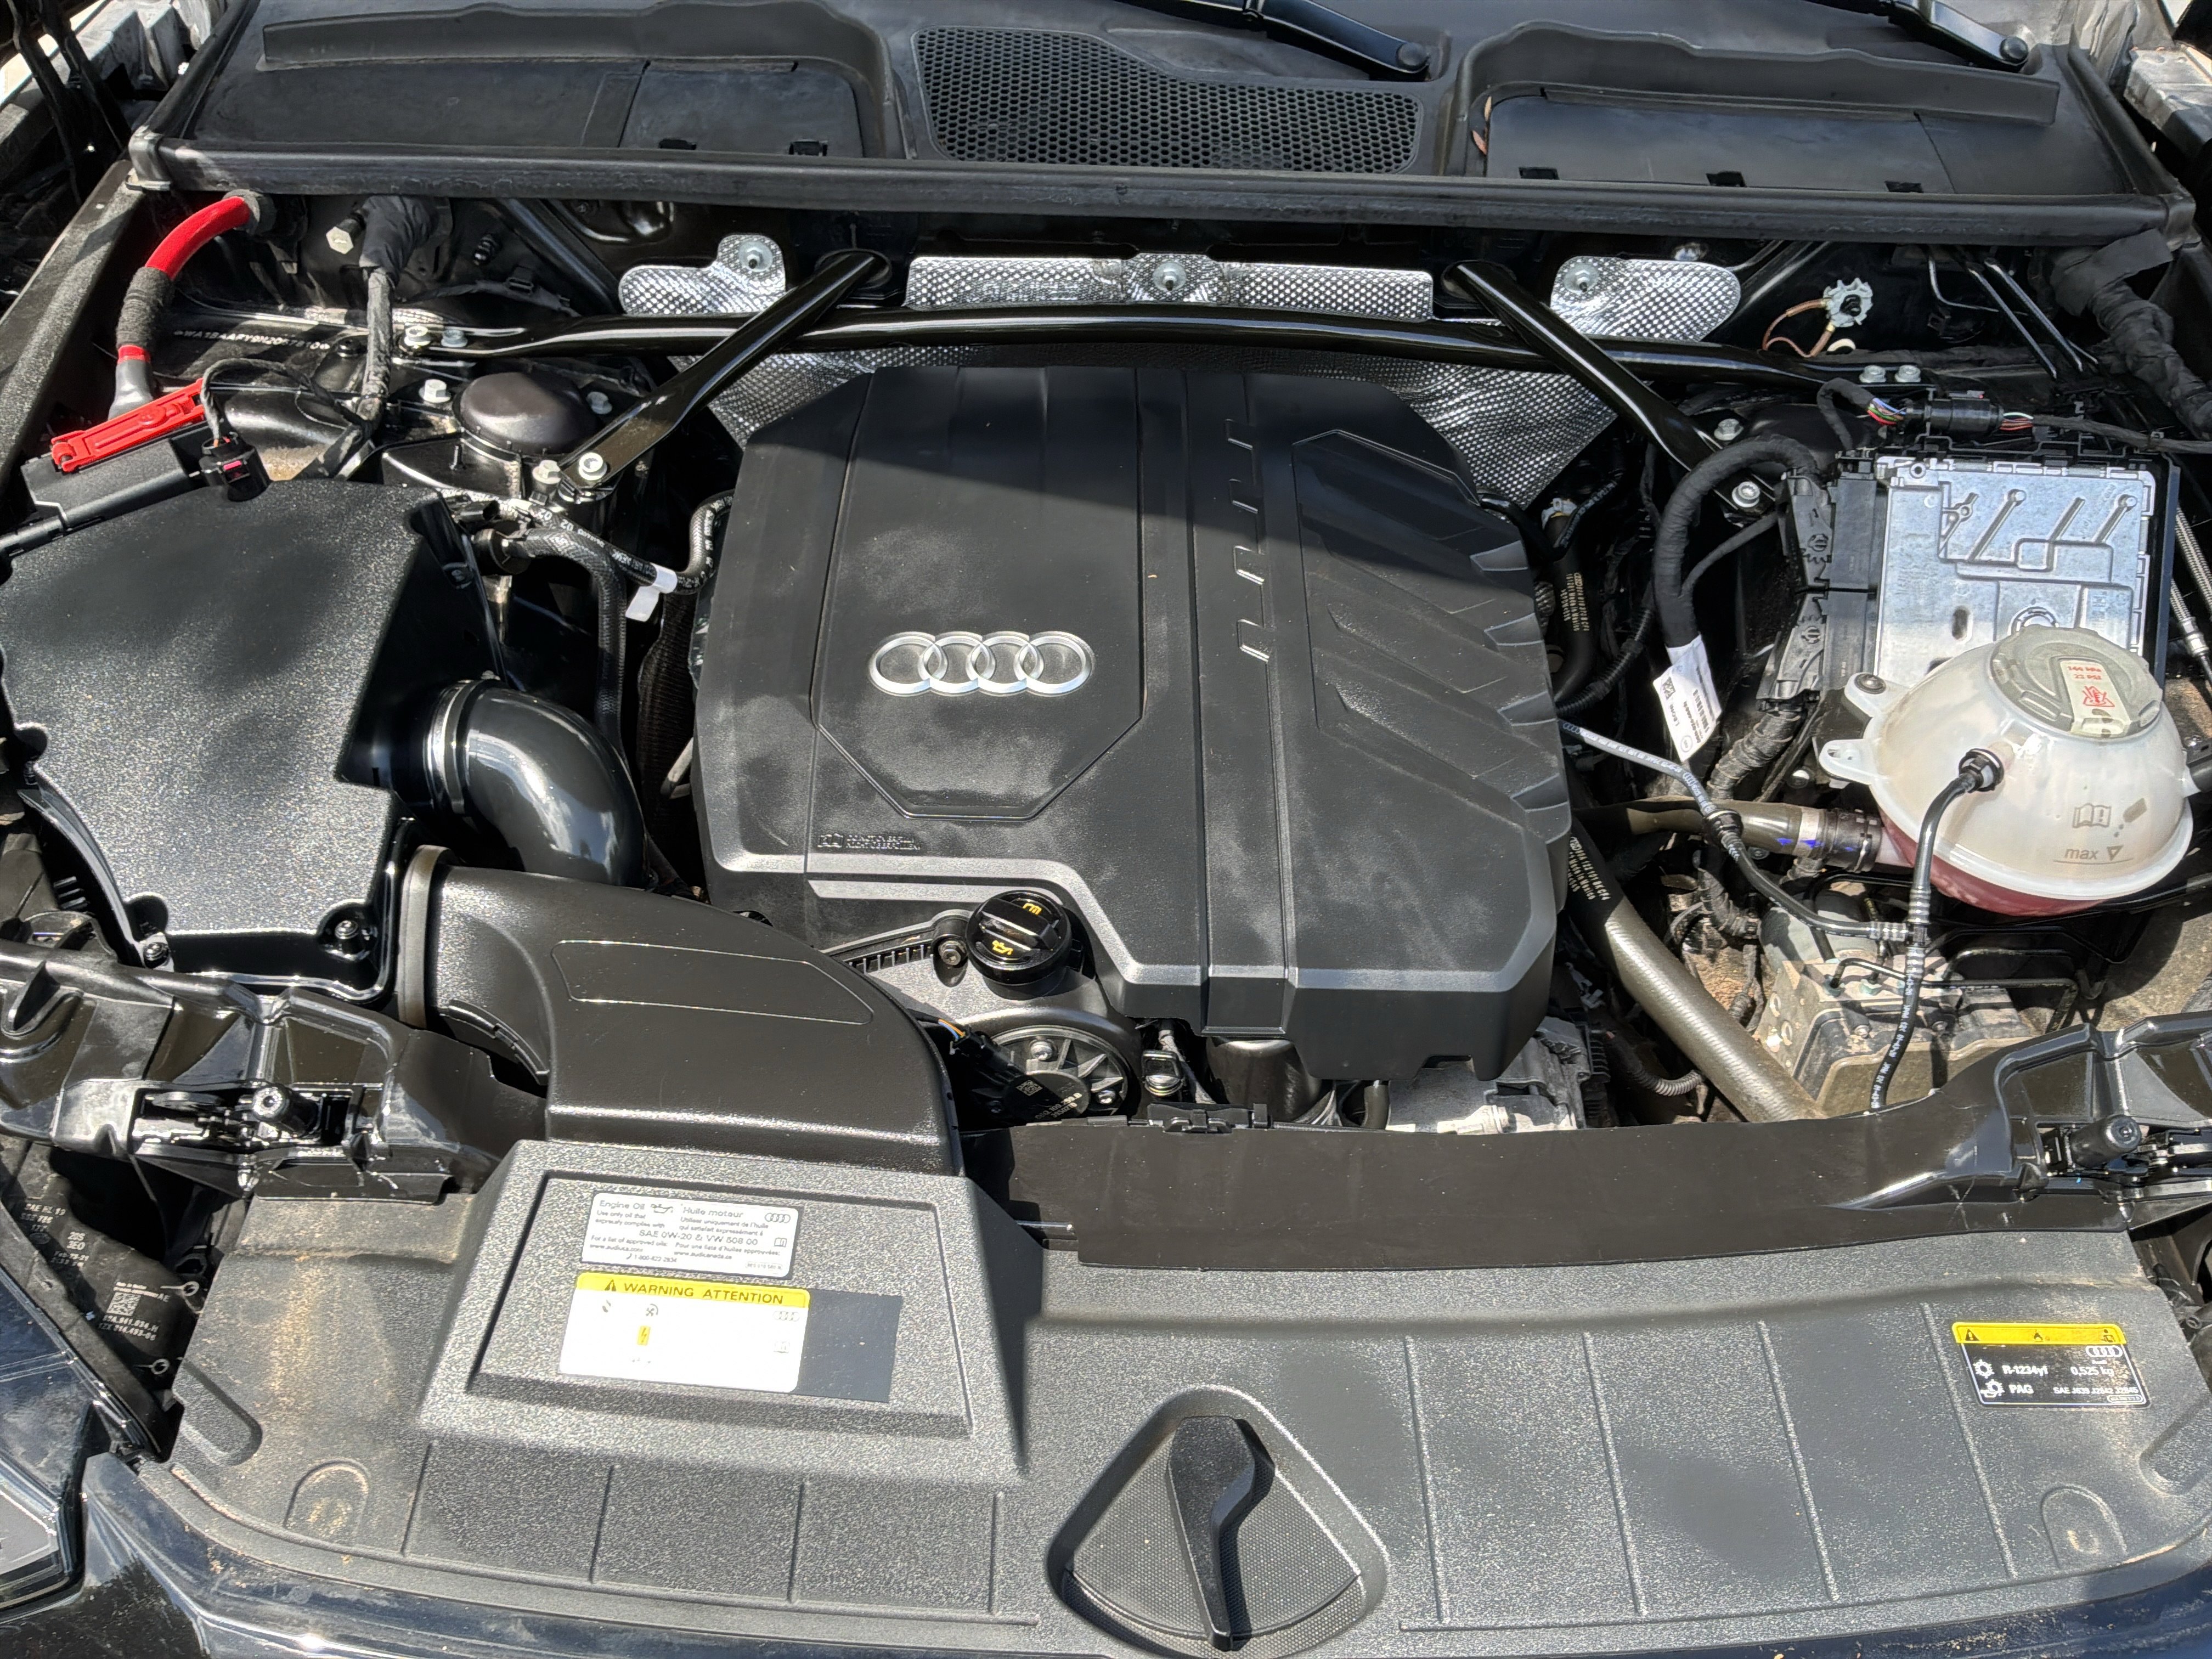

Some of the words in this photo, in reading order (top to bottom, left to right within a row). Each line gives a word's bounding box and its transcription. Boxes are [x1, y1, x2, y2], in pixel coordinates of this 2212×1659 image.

[2064, 849, 2099, 860] max
[600, 1200, 629, 1209] Engine
[682, 1207, 706, 1215] Huile
[708, 1210, 743, 1218] moteur
[639, 1229, 658, 1238] SAE
[661, 1232, 692, 1240] 0W-20
[706, 1234, 724, 1243] VW
[624, 1283, 694, 1297] WARNING
[703, 1289, 783, 1304] ATTENTION
[2002, 1365, 2048, 1376] R-1234yf
[2070, 1367, 2099, 1376] 0,525
[2100, 1367, 2114, 1377] kg
[2008, 1384, 2034, 1394] PAG
